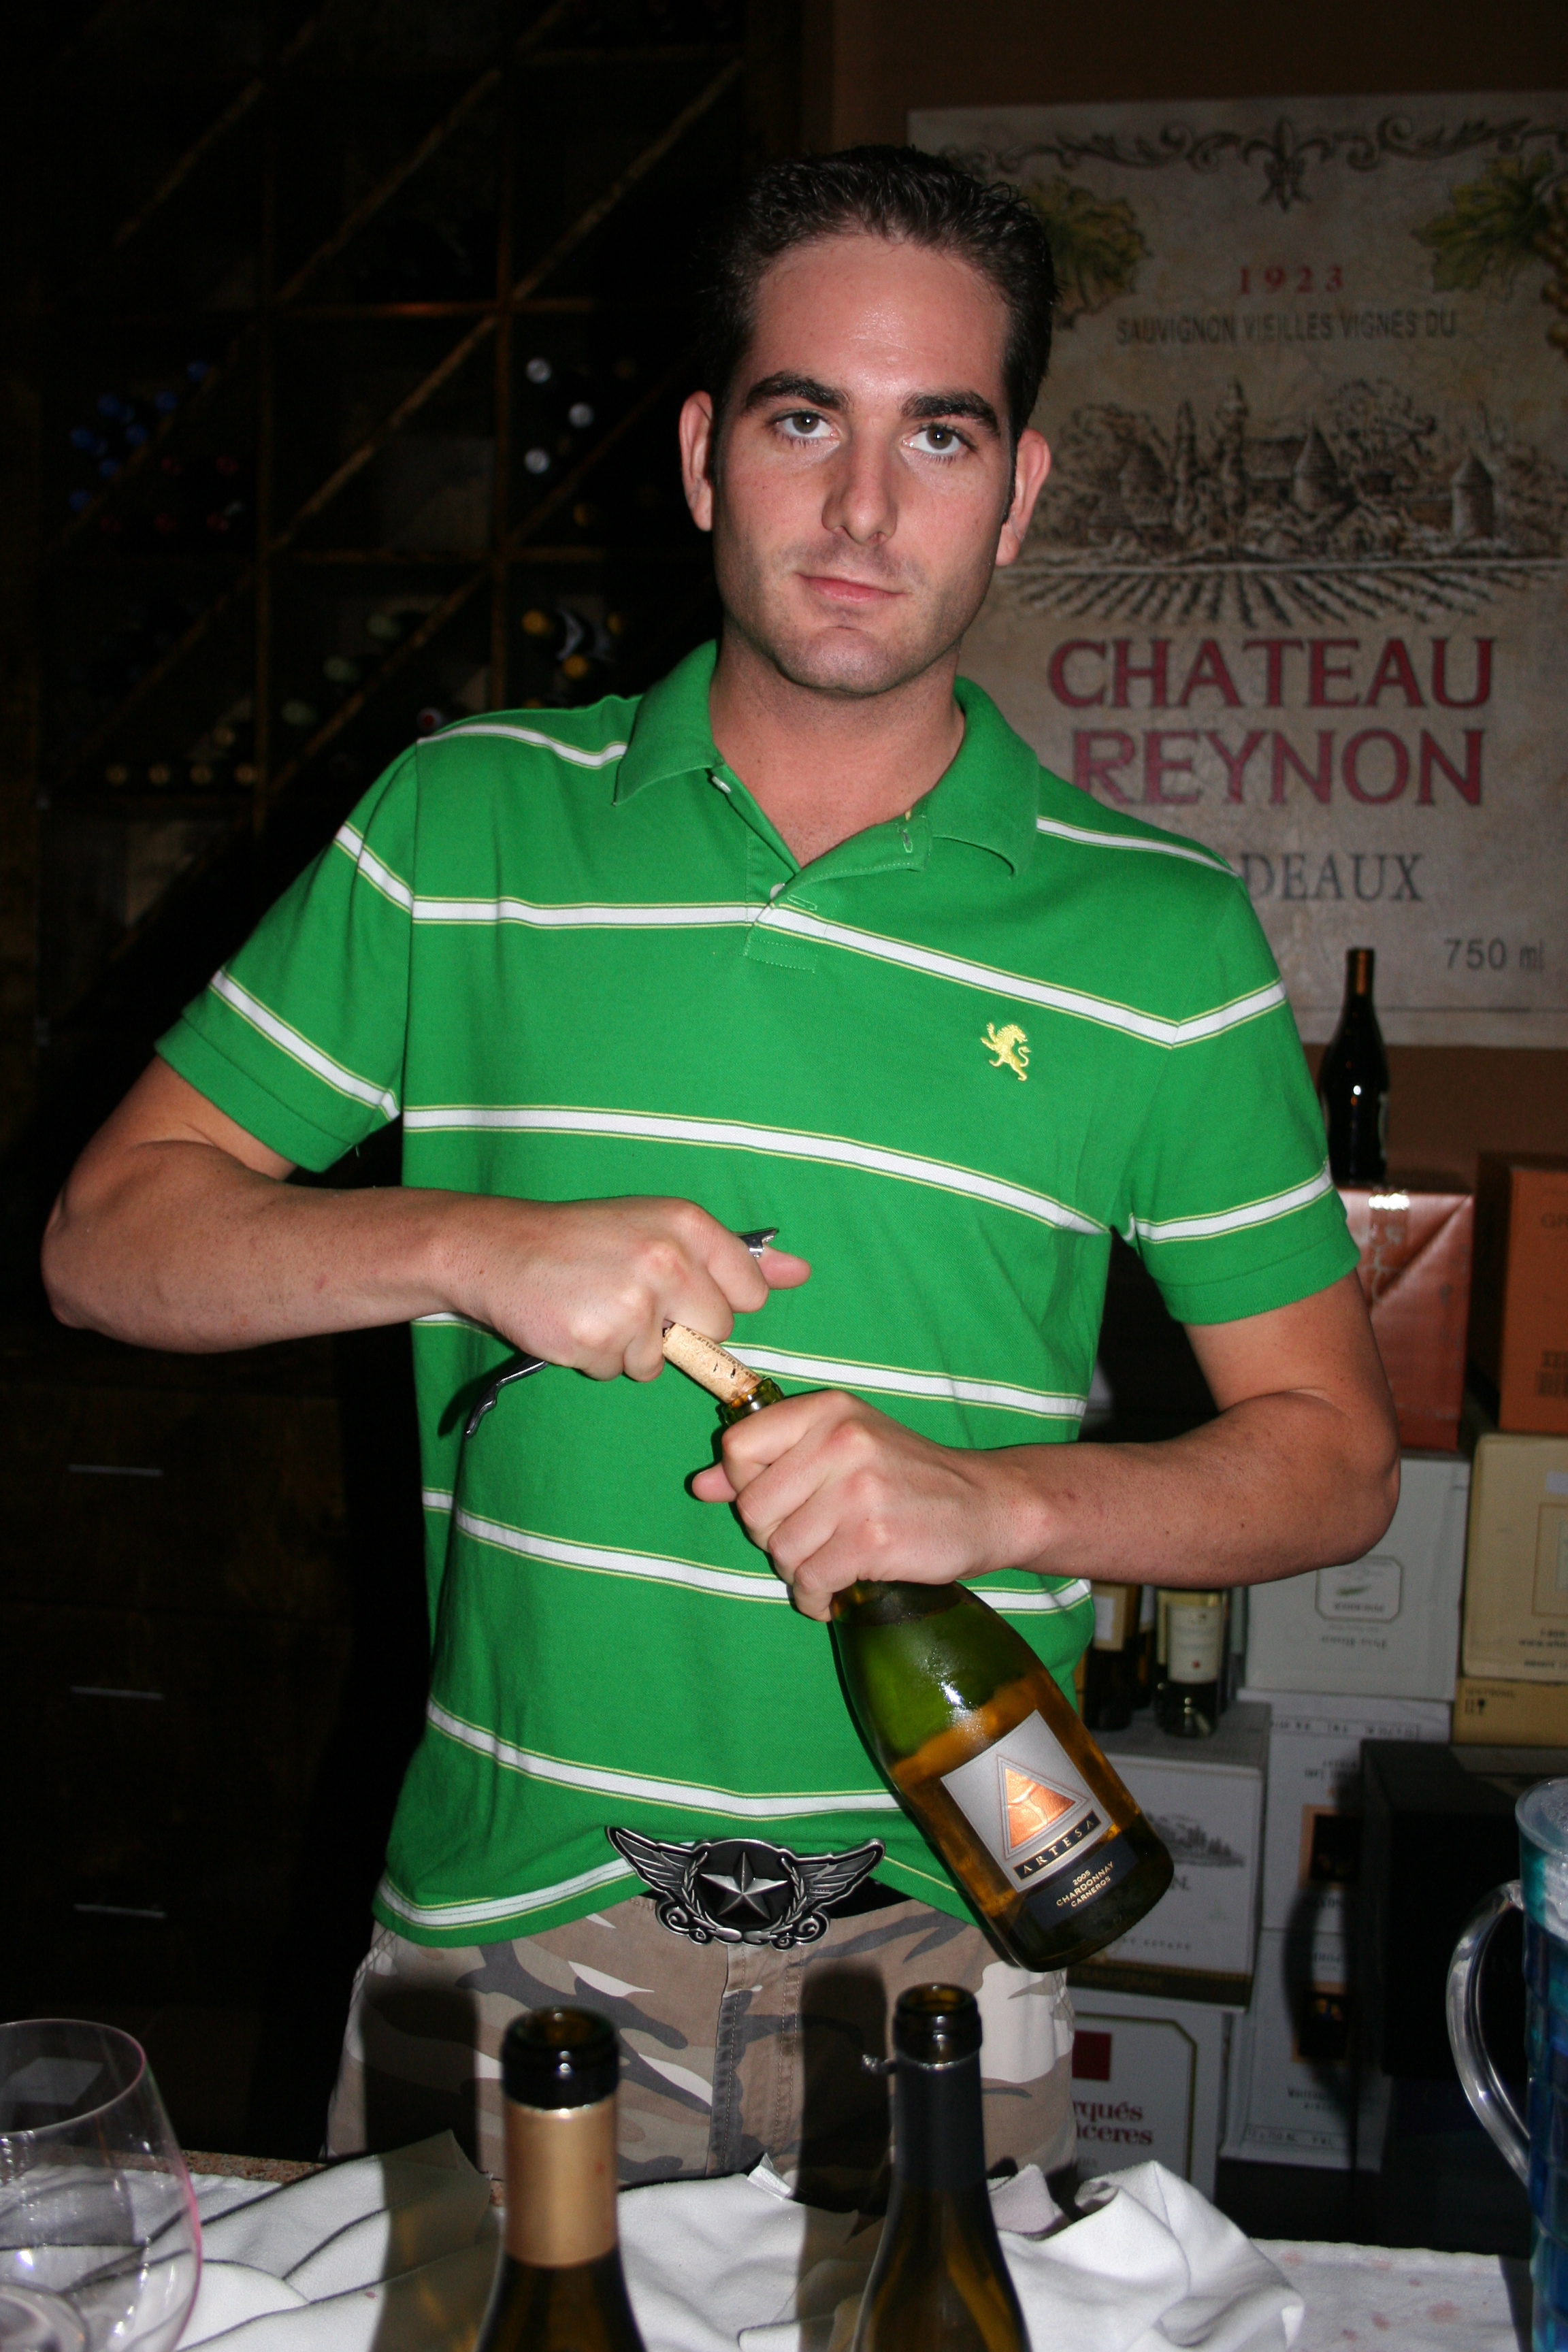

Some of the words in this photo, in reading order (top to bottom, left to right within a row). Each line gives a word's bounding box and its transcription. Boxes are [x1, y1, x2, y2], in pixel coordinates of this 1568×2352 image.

[1239, 263, 1344, 295] 1923
[1115, 313, 1235, 345] SAUVIGNON
[1242, 310, 1332, 342] VIEILLES
[1340, 308, 1418, 340] VIGNES
[1424, 308, 1457, 339] DU
[1048, 637, 1497, 709] CHATEAU
[1073, 727, 1486, 806] REYNON
[1240, 852, 1426, 902] DEAUX
[1443, 938, 1507, 970] 750
[1518, 937, 1545, 971] ml
[1023, 1819, 1094, 1874] ARTESA
[1056, 1861, 1114, 1907] CHARDONNAY
[1071, 1876, 1111, 1908] CARNEROS
[1073, 1869, 1091, 1886] 2005
[1073, 2100, 1143, 2122] rqués
